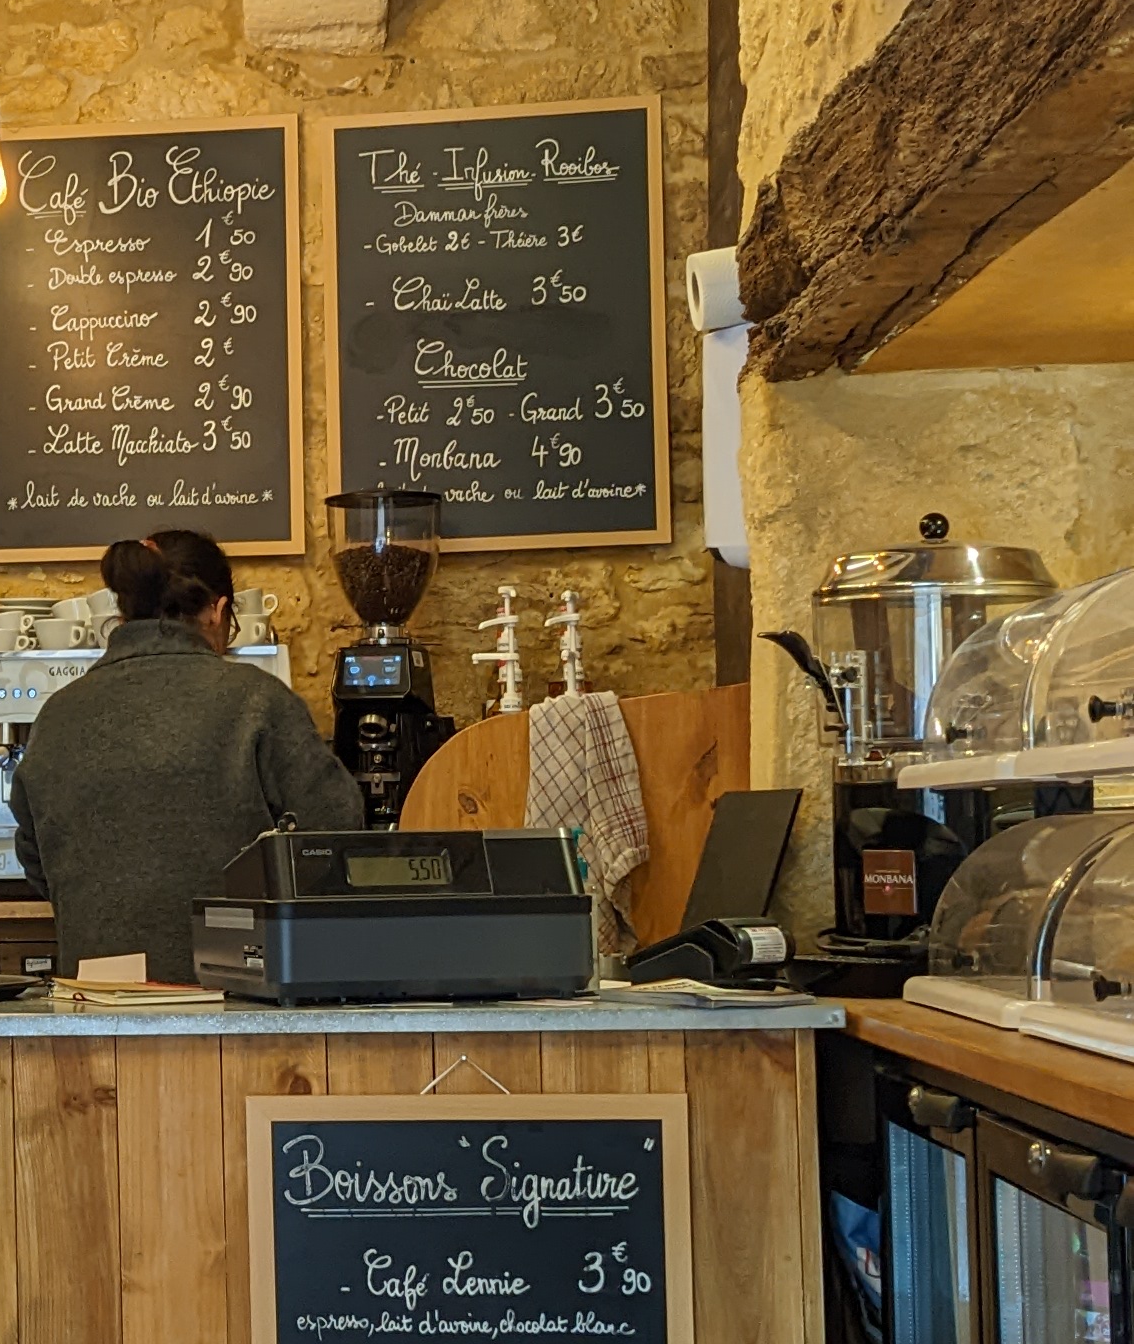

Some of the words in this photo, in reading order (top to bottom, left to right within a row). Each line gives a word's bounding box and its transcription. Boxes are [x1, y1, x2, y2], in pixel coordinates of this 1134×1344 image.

[17, 150, 89, 226] Café
[98, 151, 160, 215] Bio
[165, 145, 276, 215] Ethiopie
[358, 148, 421, 185] Thé
[441, 147, 530, 202] Infusion
[535, 138, 620, 178] Rooibos
[44, 228, 151, 263] Espresso
[375, 233, 438, 256] Gobelet
[48, 264, 104, 291] Double
[108, 268, 178, 295] espresso
[454, 277, 508, 311] Latte
[50, 304, 159, 342] Cappuccino
[46, 340, 96, 371] Petit
[414, 338, 528, 381] Chocolat
[45, 384, 107, 414] Grand
[383, 395, 430, 425] Petit
[520, 391, 584, 425] Grand
[43, 423, 104, 455] Latte
[111, 423, 200, 467] Macchiato
[393, 436, 502, 482] Monbana
[20, 480, 60, 510] lait
[66, 487, 89, 508] de
[92, 482, 138, 507] vache
[146, 494, 165, 507] ou
[168, 478, 200, 507] lait
[444, 480, 495, 503] vache
[504, 488, 523, 500] ou
[532, 480, 566, 500] lait
[48, 666, 85, 676] GAGGIA
[864, 873, 914, 884] MONBANA
[282, 1134, 458, 1206] Boissons
[363, 1248, 428, 1311] Café
[442, 1250, 531, 1296] Lennie
[374, 1312, 413, 1333] lait
[499, 1308, 569, 1334] chocolat
[570, 1313, 636, 1335] blanc
